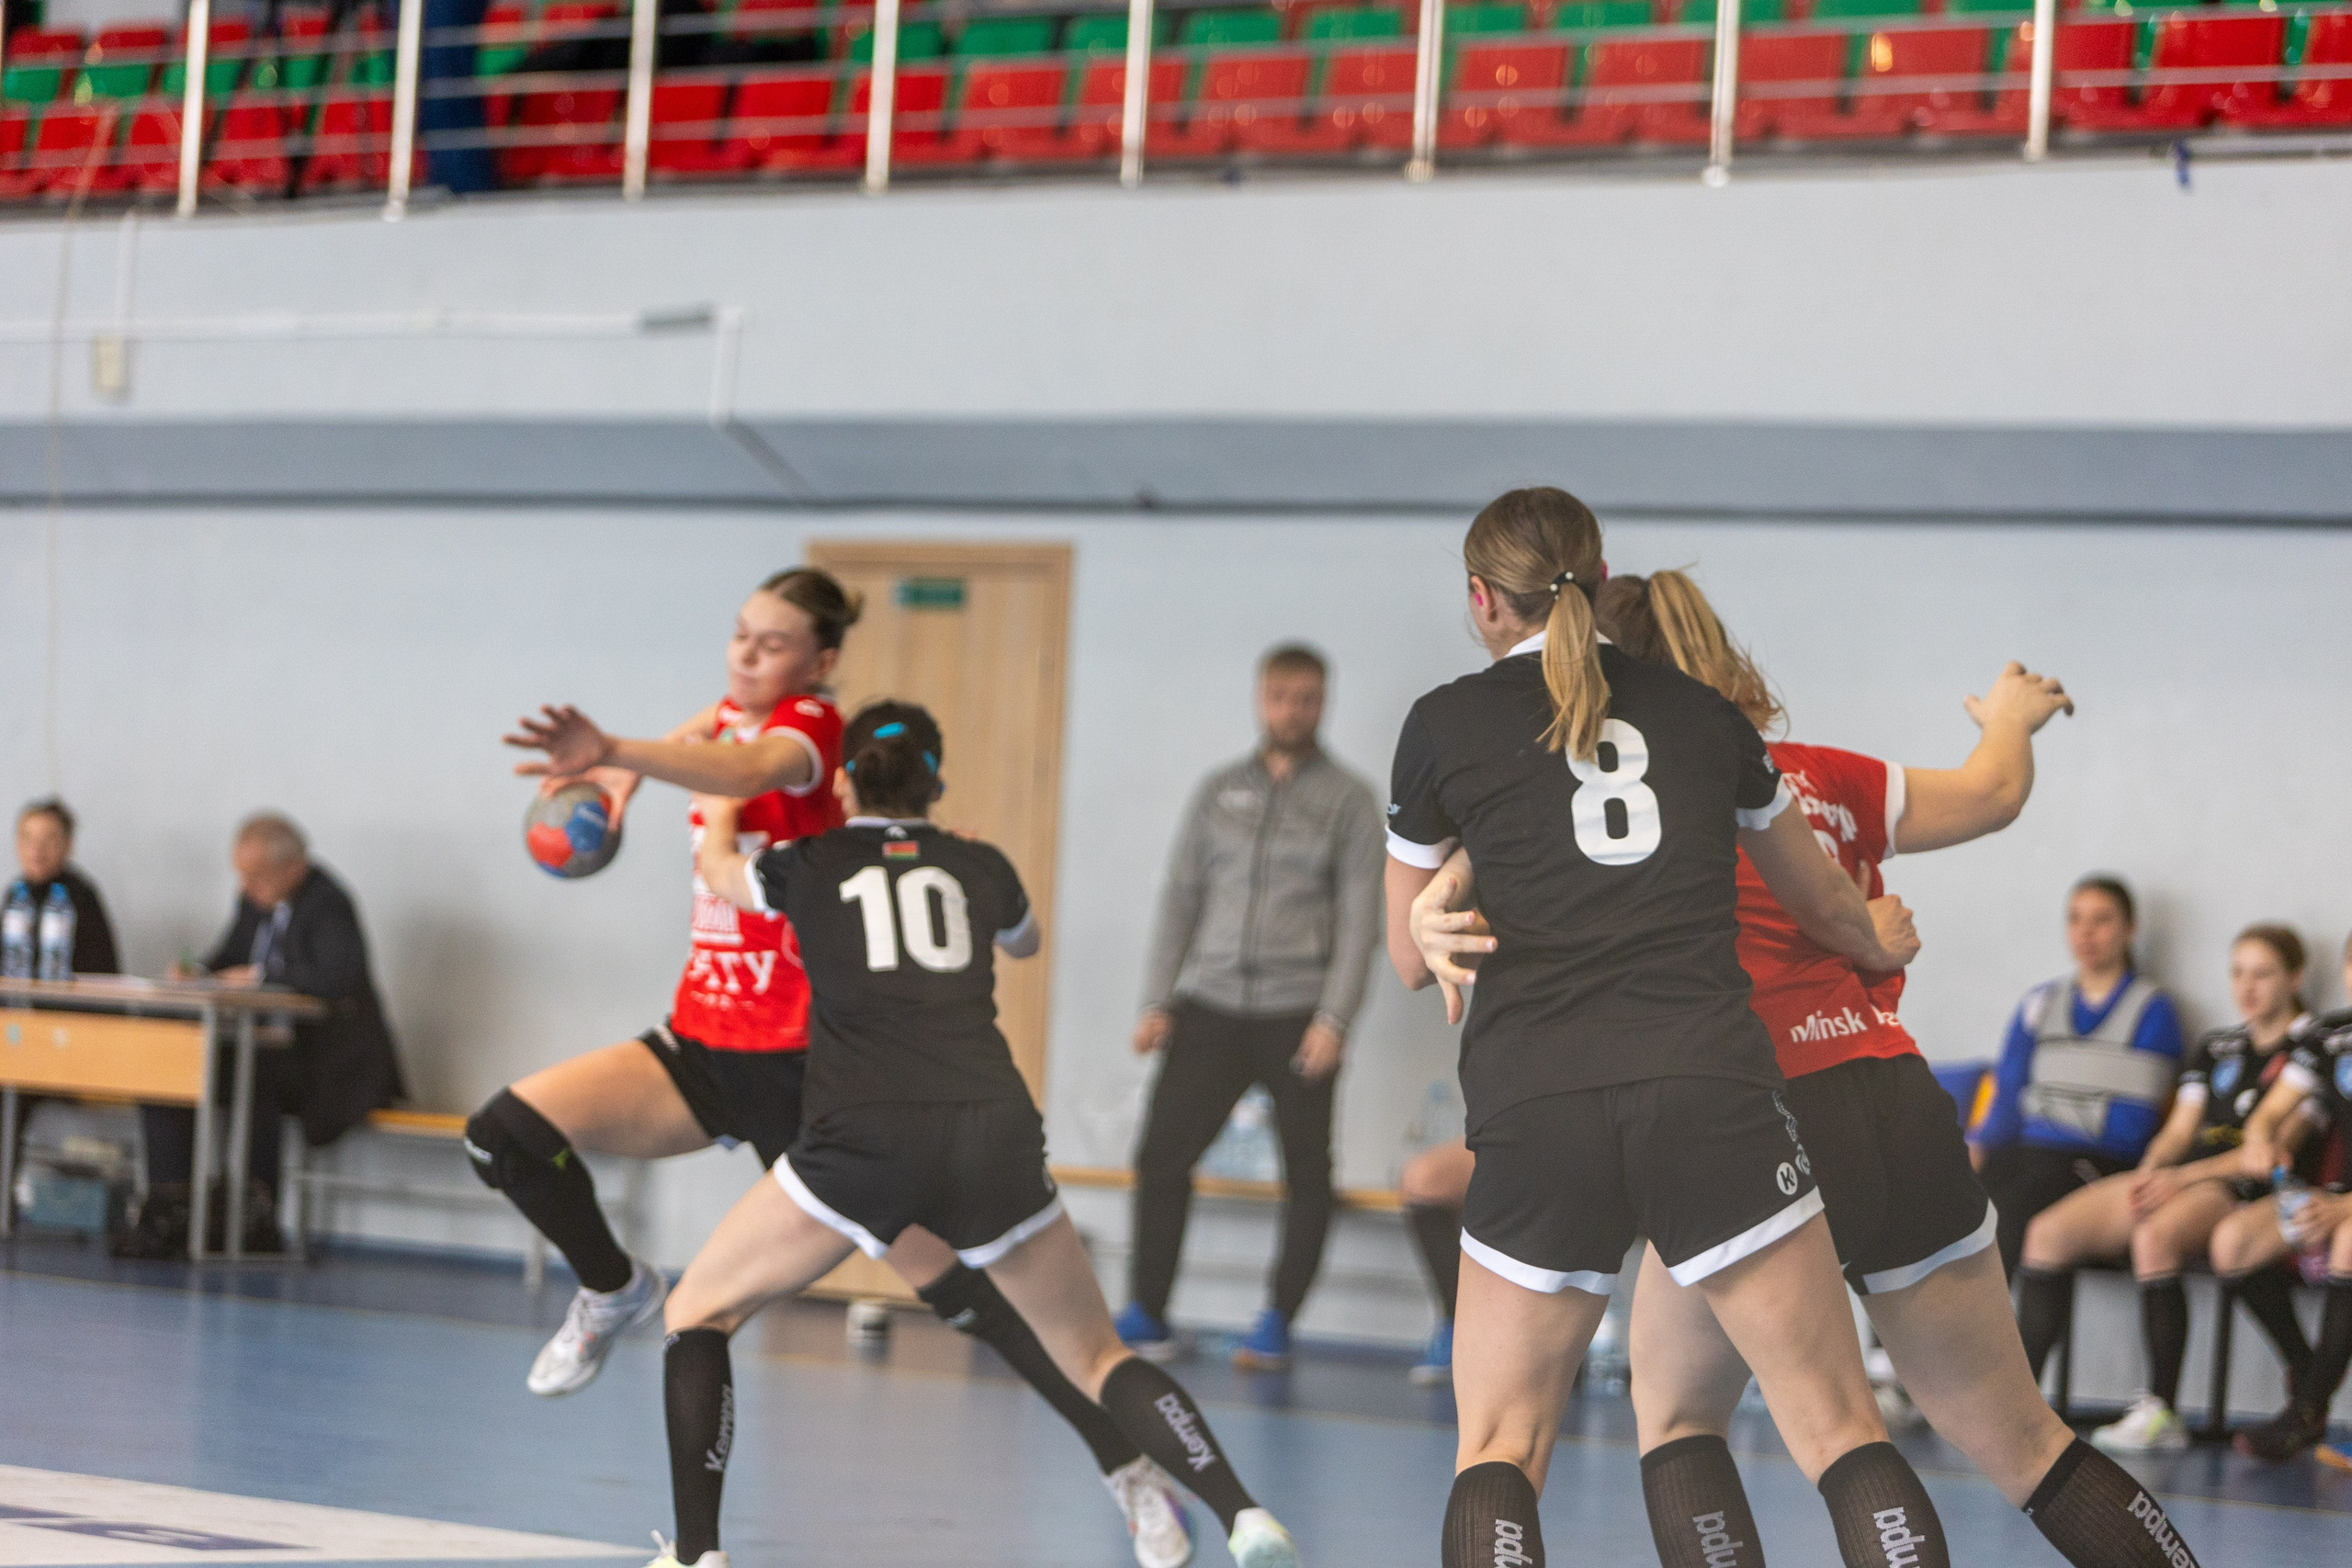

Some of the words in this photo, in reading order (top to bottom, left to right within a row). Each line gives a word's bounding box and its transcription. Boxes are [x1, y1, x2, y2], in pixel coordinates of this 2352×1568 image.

[1565, 718, 1662, 865] 8
[839, 865, 973, 972] 10
[1790, 1007, 1868, 1043] Minsk
[1154, 1392, 1216, 1472] Kempa
[2127, 1491, 2193, 1568] empa
